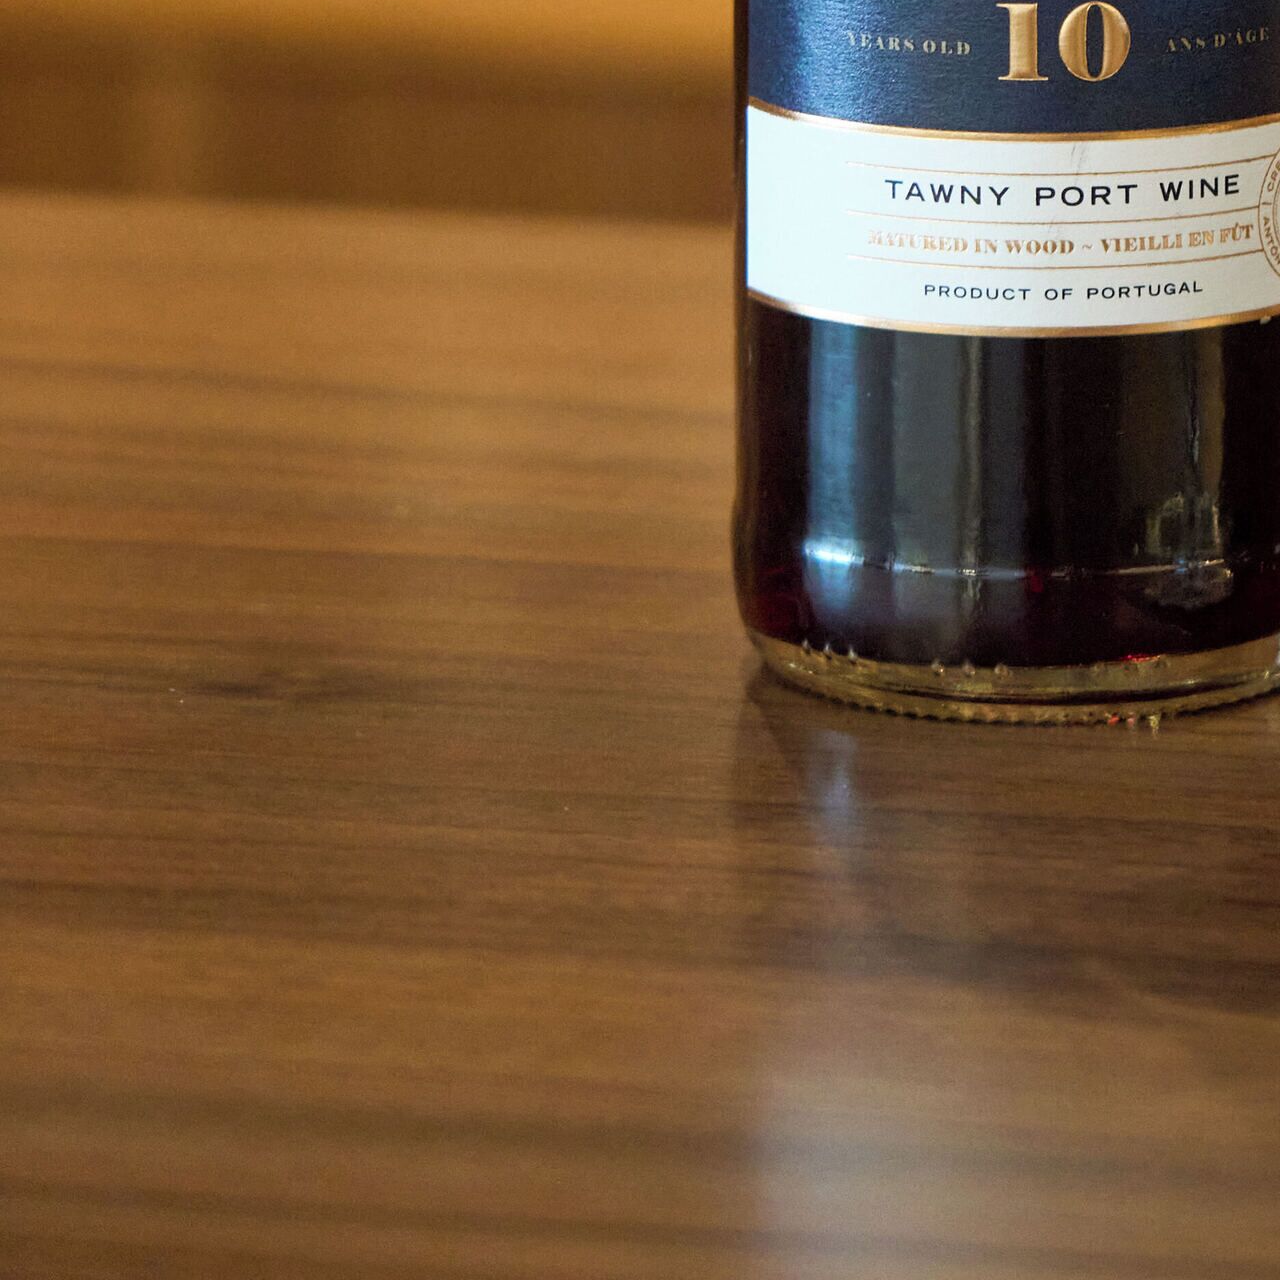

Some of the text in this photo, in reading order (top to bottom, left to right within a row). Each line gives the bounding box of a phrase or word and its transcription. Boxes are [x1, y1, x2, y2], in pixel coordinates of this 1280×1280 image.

[848, 31, 915, 52] YEARS
[922, 39, 971, 55] OLD
[996, 1, 1131, 82] 10
[1166, 37, 1206, 52] ANS
[885, 174, 1241, 207] TAWNY PORT WINE
[868, 230, 968, 252] MATURED
[974, 239, 998, 254] IN
[1005, 239, 1075, 256] WOOD
[1101, 233, 1183, 253] VIEILLI
[1188, 230, 1214, 247] EN
[924, 281, 1204, 301] PRODUCT OF PORTUGAL
